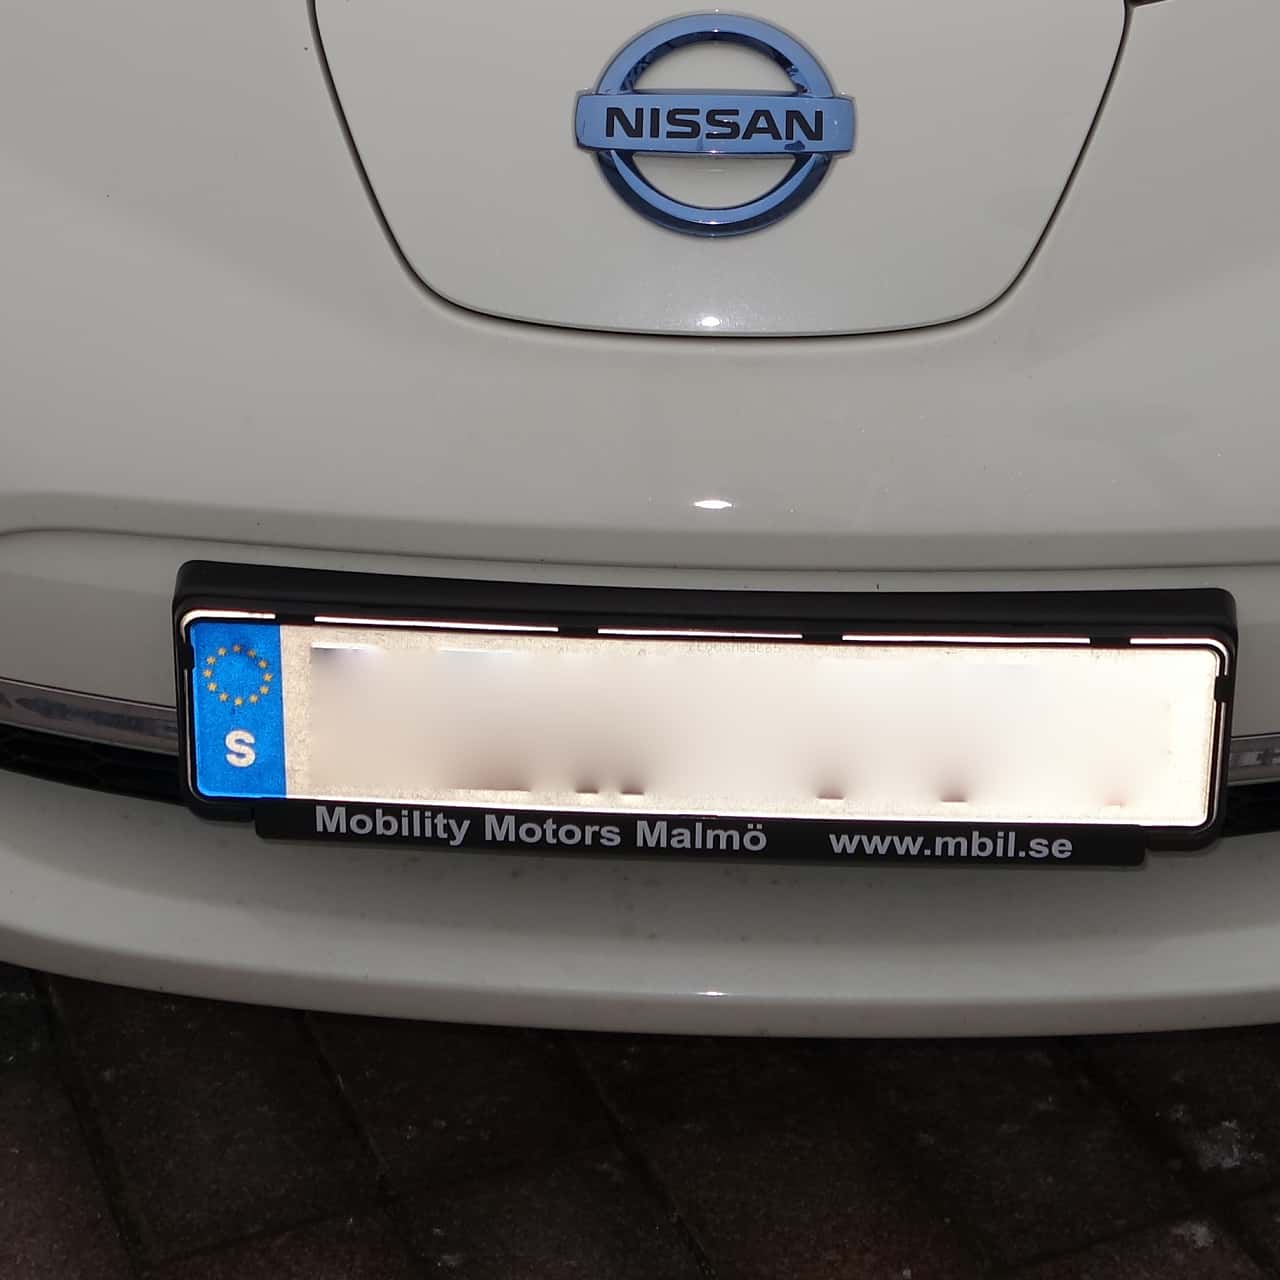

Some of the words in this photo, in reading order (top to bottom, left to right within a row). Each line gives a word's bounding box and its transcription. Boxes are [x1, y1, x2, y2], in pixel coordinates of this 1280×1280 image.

[605, 106, 824, 141] NISSAN
[224, 729, 256, 768] S
[314, 804, 471, 847] Mobility
[484, 813, 622, 847] Motors
[635, 819, 768, 852] Malmö
[828, 830, 1074, 859] www.mbil.se
